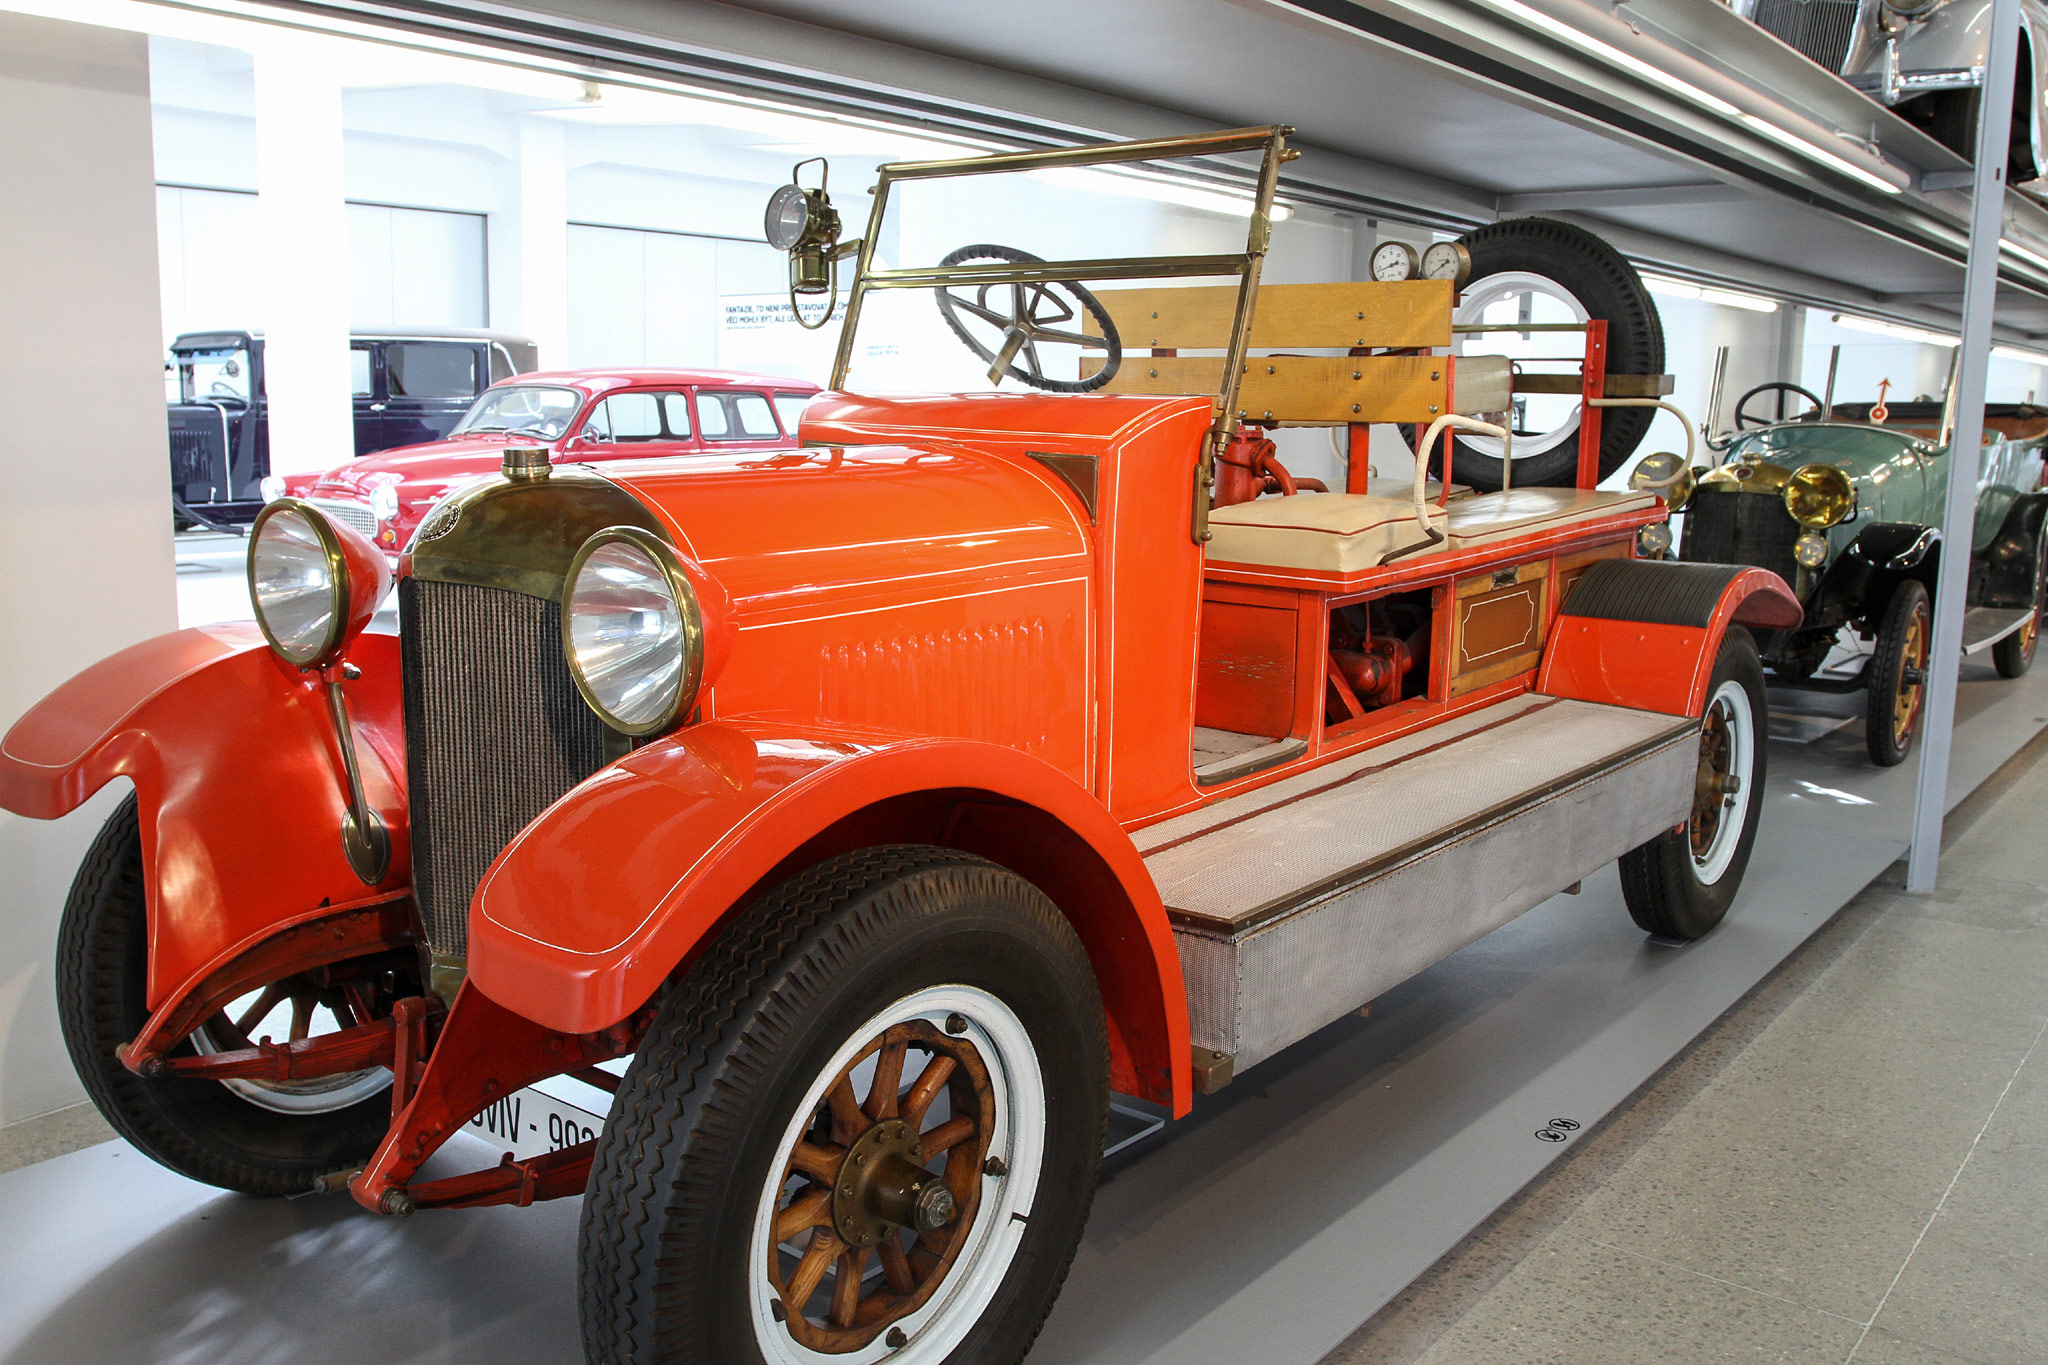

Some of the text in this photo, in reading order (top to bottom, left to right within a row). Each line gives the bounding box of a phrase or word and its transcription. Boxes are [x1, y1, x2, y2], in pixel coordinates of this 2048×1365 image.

[726, 305, 754, 313] FANTAZIE,
[740, 315, 759, 323] MOHLY
[813, 313, 822, 321] TO
